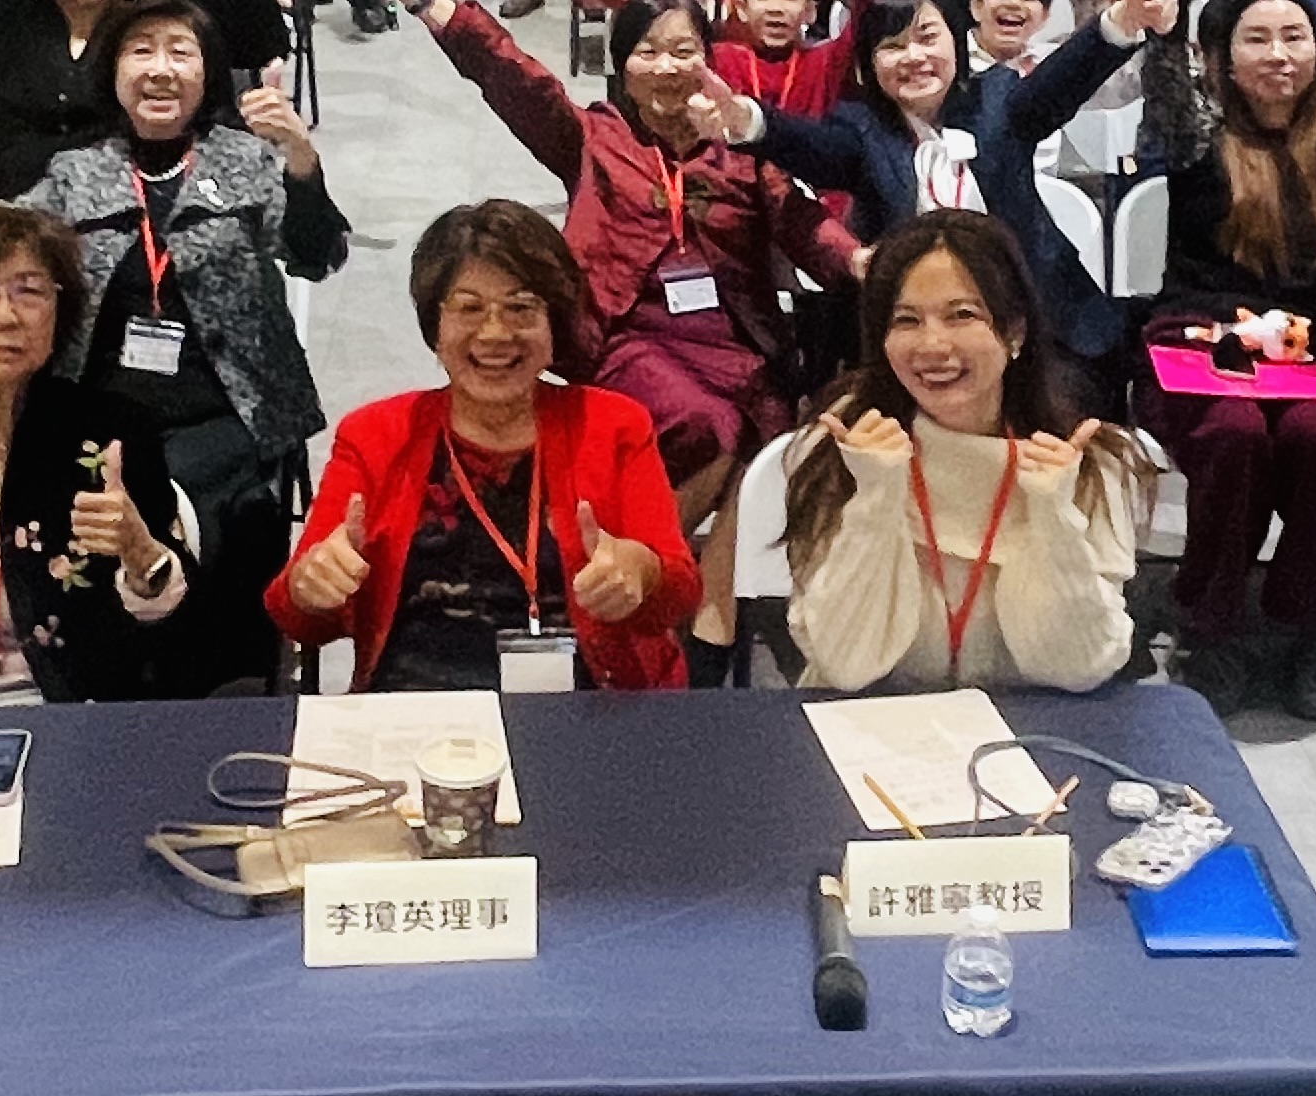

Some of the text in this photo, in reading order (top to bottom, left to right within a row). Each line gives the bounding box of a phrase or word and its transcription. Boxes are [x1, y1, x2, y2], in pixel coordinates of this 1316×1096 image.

[326, 897, 510, 936] 李瓊英理事
[868, 880, 1044, 918] 許雅寧教授
